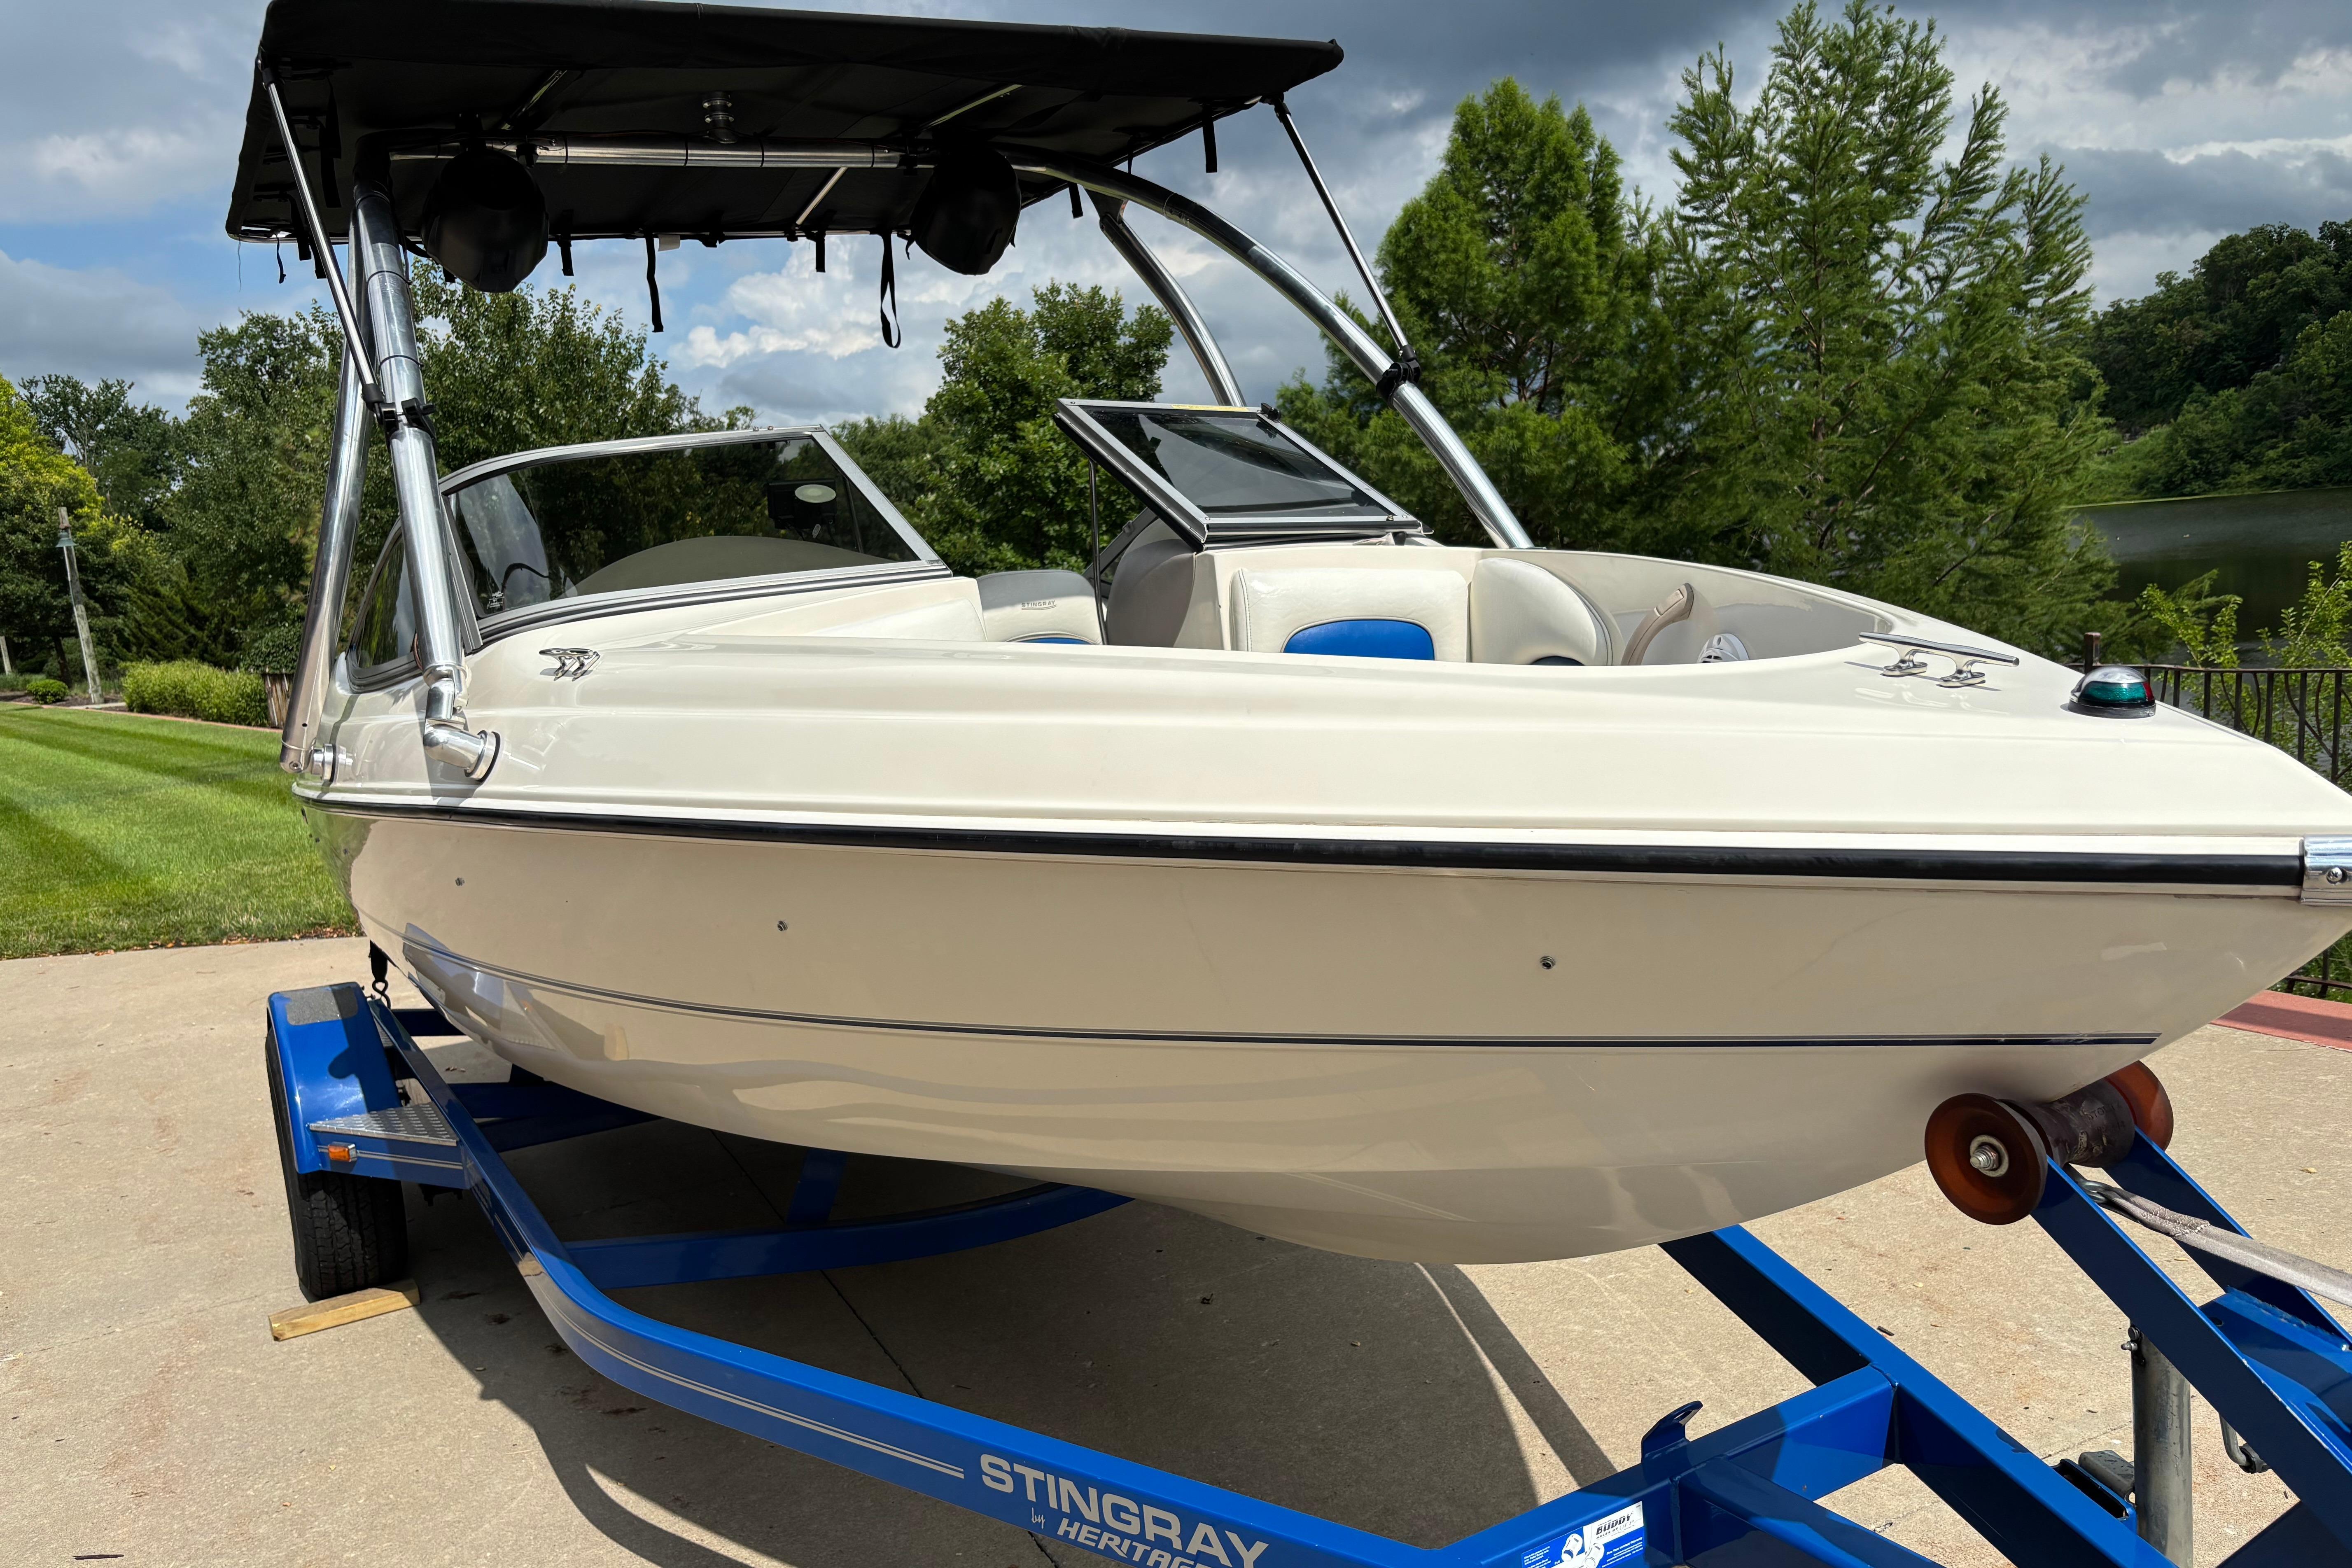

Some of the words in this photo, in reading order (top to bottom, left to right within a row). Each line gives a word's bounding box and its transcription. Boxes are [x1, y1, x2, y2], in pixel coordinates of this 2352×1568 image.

[980, 1454, 1269, 1568] STINGRAY
[1031, 1507, 1045, 1529] by
[1057, 1518, 1215, 1568] HERITAG
[1596, 1514, 1631, 1535] BUDDY
